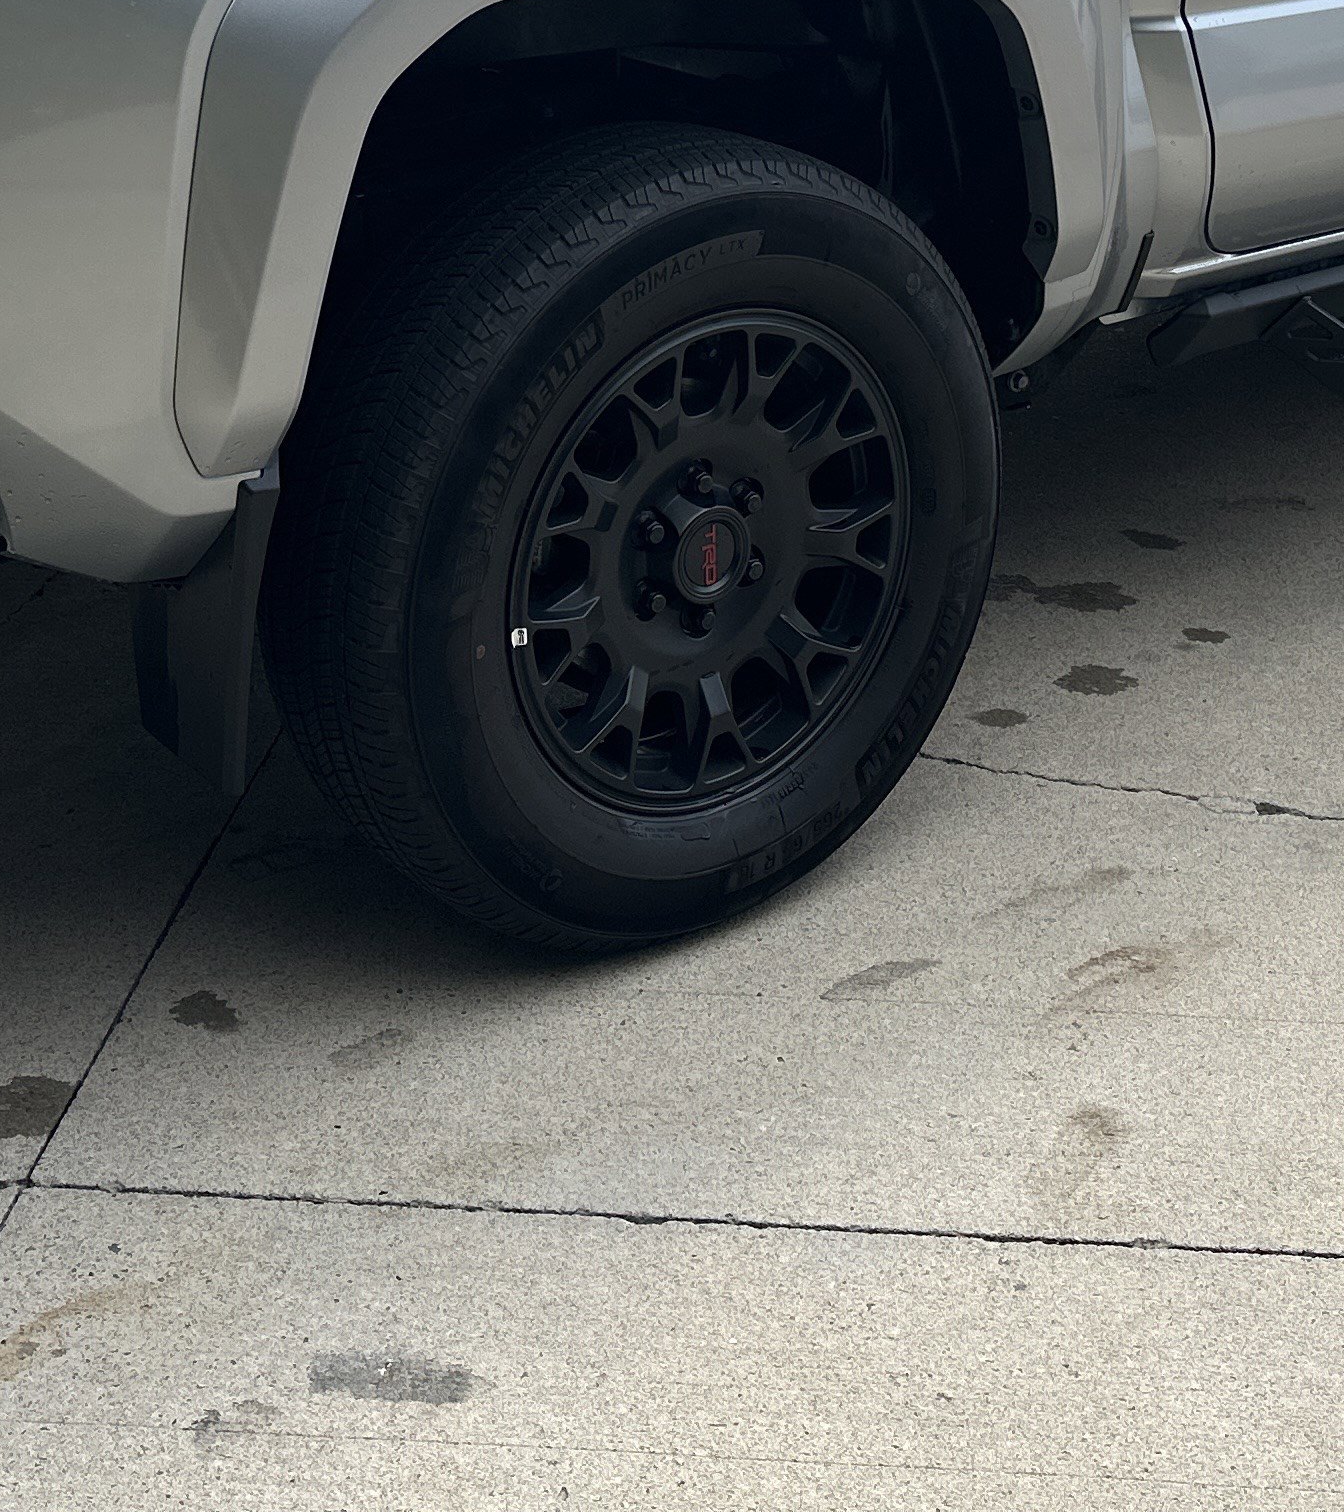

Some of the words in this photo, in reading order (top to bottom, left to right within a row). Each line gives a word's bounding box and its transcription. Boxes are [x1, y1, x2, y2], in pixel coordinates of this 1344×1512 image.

[621, 246, 713, 311] PRIMACY
[719, 239, 747, 255] LTX
[474, 320, 598, 521] MICHELIN
[701, 522, 718, 586] TRD
